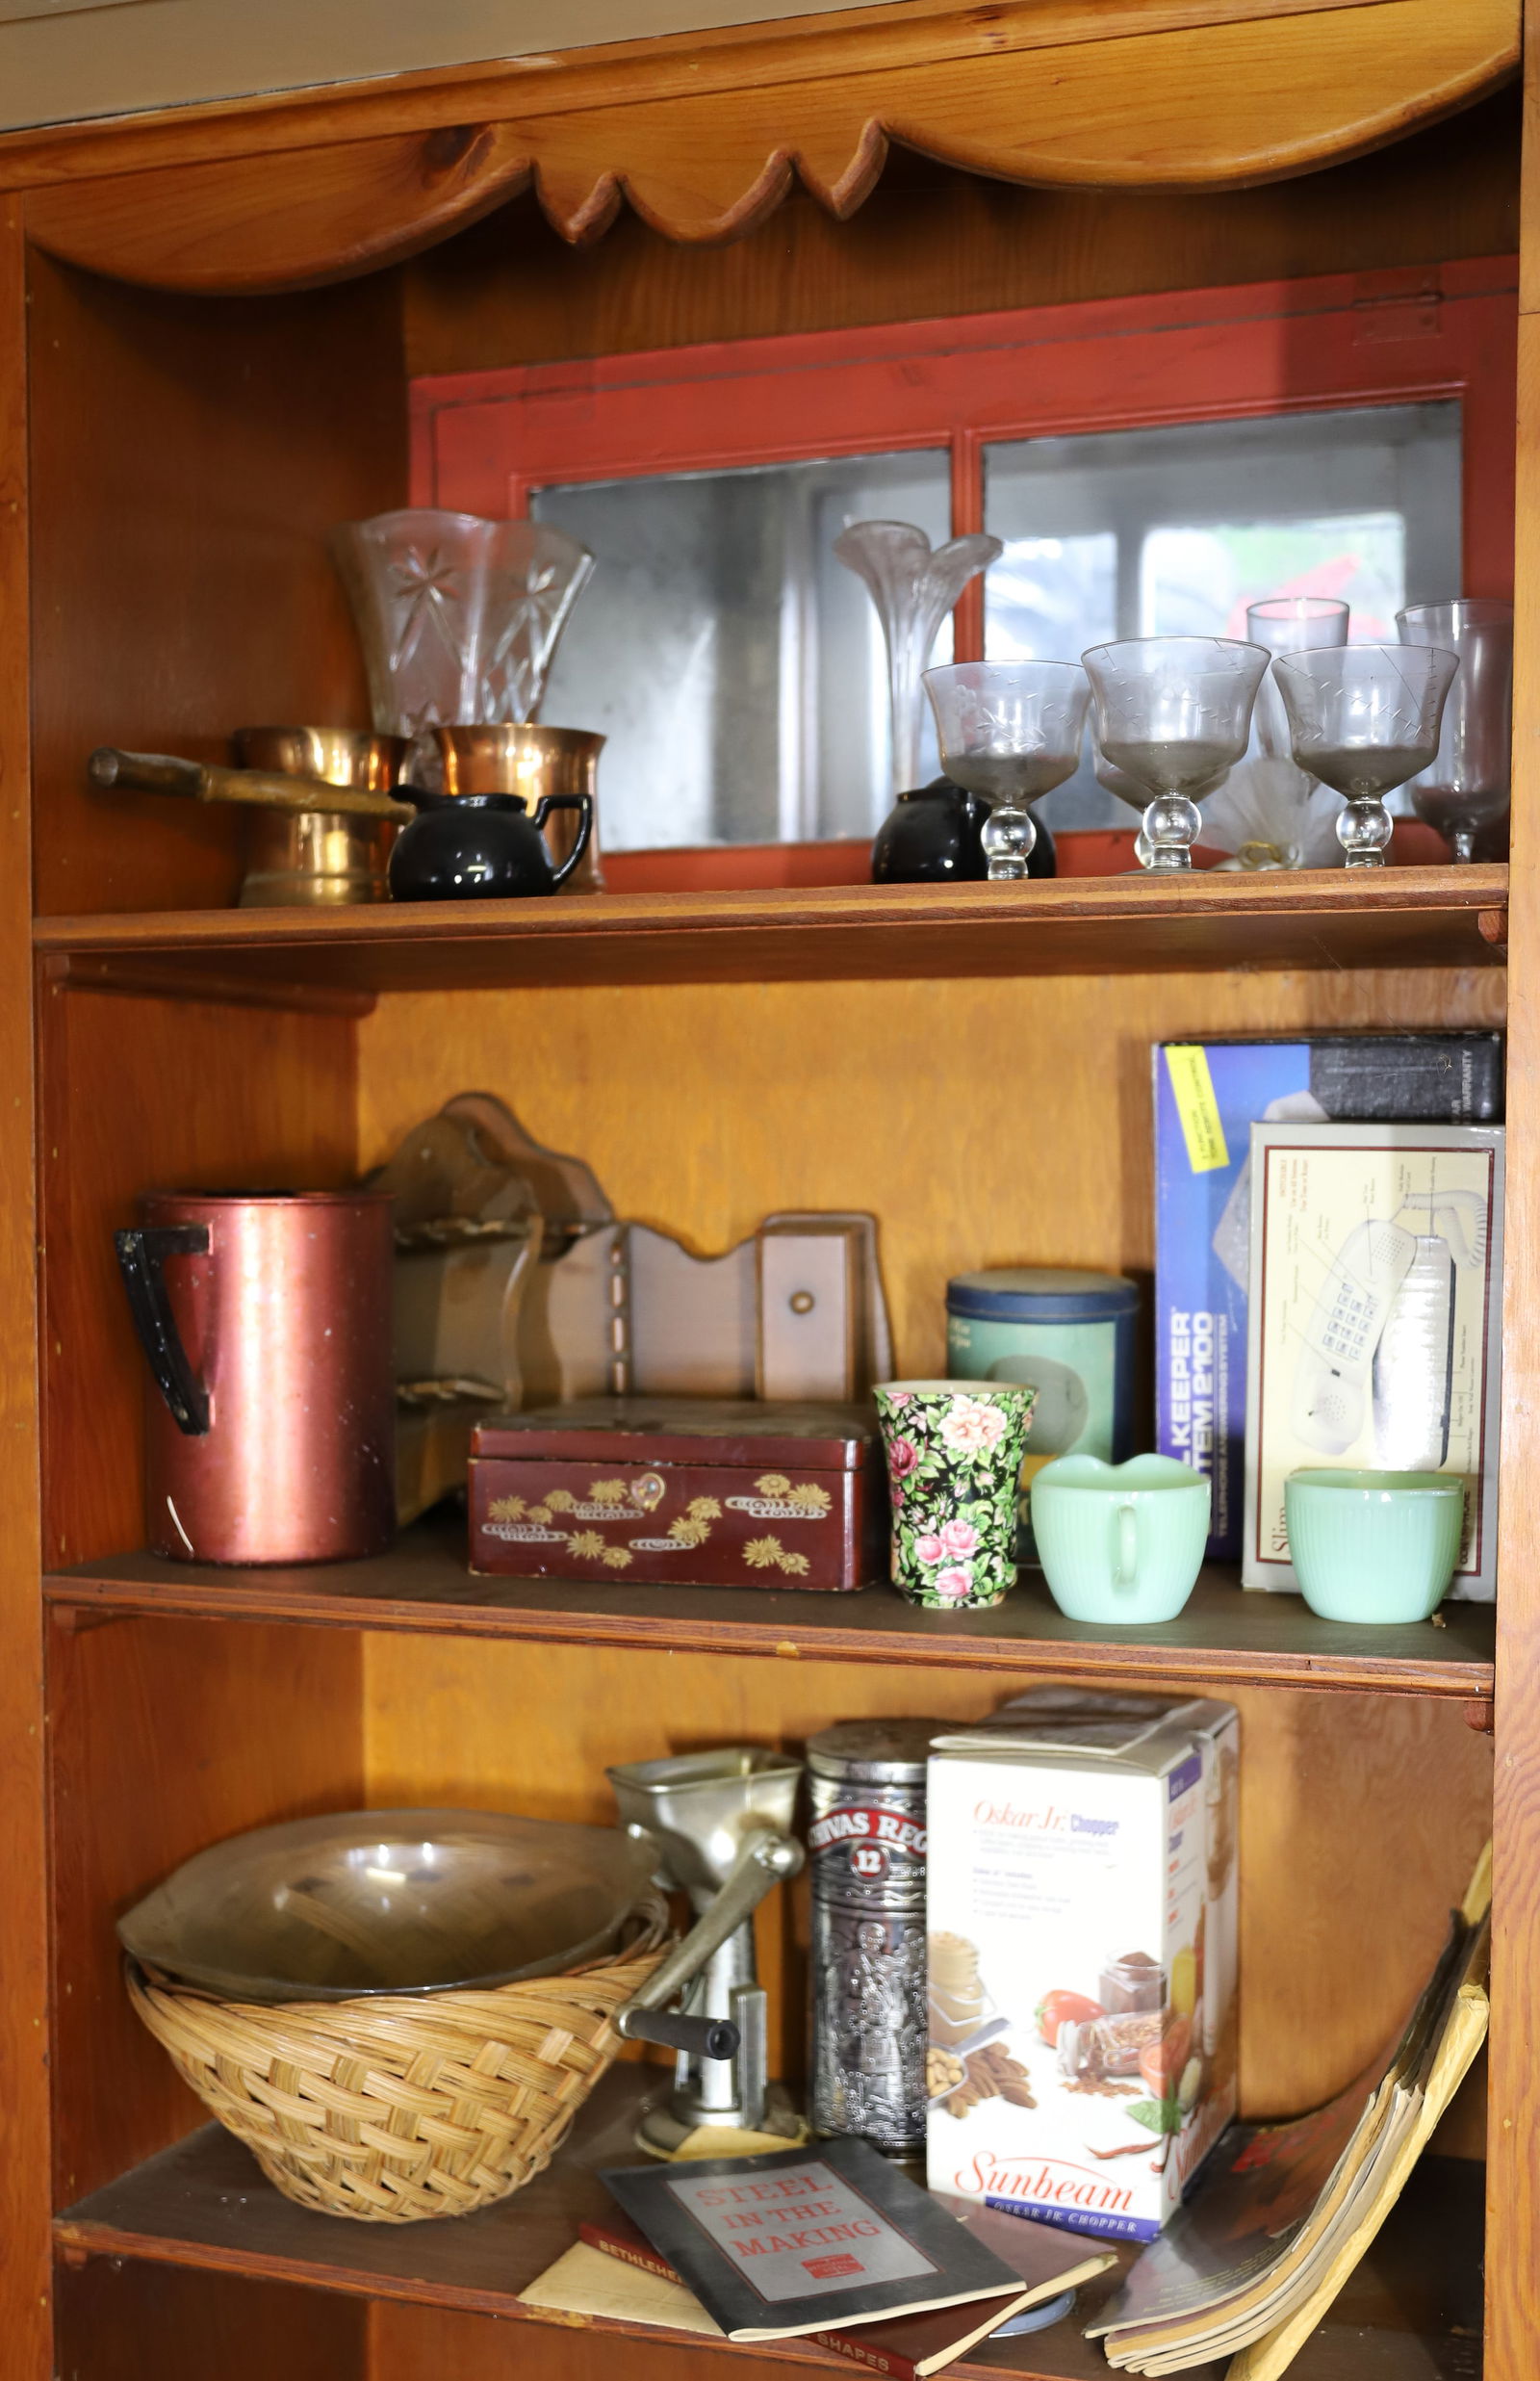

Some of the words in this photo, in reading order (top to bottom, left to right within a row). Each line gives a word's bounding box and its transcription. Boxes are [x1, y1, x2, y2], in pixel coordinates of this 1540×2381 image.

[1462, 1049, 1473, 1112] WARRANTY
[1193, 1312, 1213, 1395] 2100
[1219, 1313, 1228, 1371] SYSTEM
[1170, 1312, 1191, 1446] KEEPER
[1193, 1400, 1213, 1481] TEM
[1219, 1372, 1228, 1456] ANSWERING
[1219, 1459, 1228, 1538] TELEPHONE
[974, 1799, 1040, 1827] Oskar
[1071, 1814, 1119, 1837] Chopper
[856, 1850, 881, 1874] 12
[695, 2176, 833, 2207] STEEL
[955, 2151, 1134, 2211] Sunbeam
[720, 2212, 764, 2229] IN
[766, 2201, 842, 2223] THE
[729, 2219, 882, 2257] MAKING
[994, 2201, 1040, 2219] OSKAR
[1067, 2213, 1137, 2234] CHOPPER
[817, 2333, 889, 2371] SHAPES
